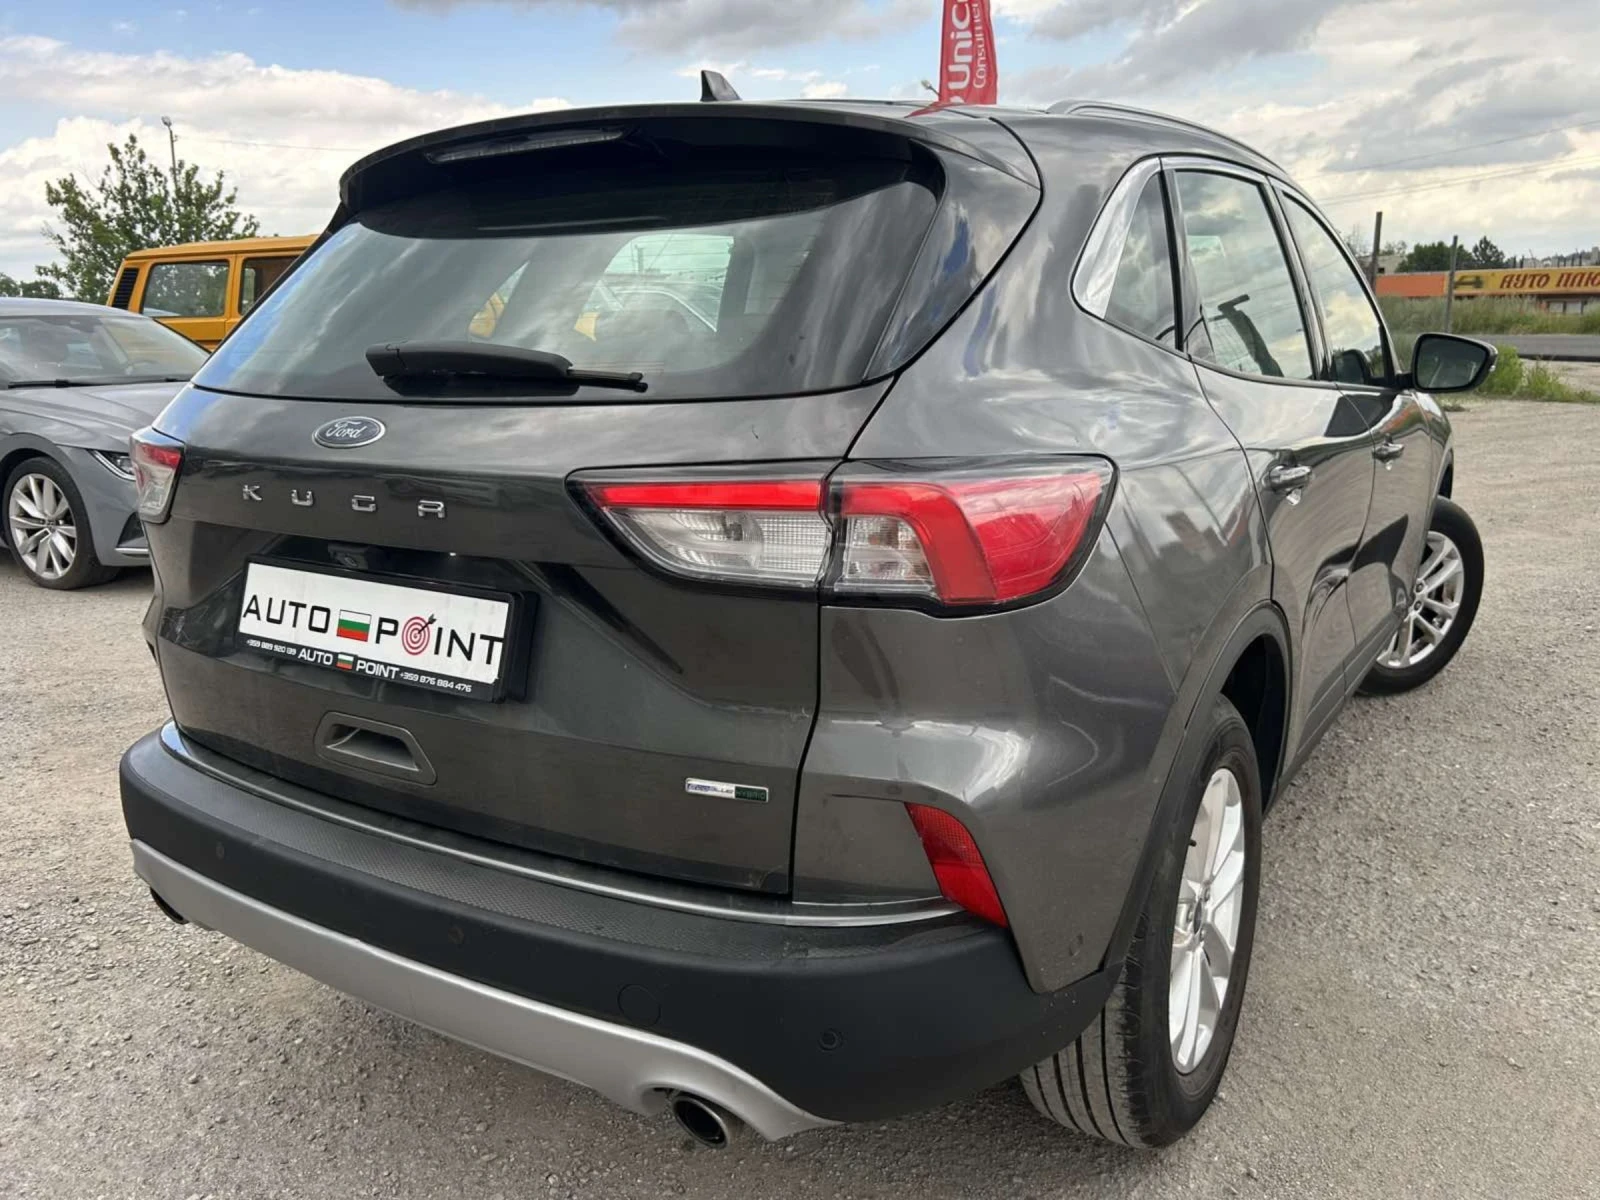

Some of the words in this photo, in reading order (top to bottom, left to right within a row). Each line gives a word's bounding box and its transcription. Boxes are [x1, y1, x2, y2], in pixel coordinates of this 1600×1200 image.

[948, 0, 973, 90] UniC
[325, 420, 368, 438] Ford
[242, 484, 446, 518] KUGA
[243, 594, 331, 634] AUTO
[298, 648, 334, 666] AUTO
[356, 659, 400, 679] POINT
